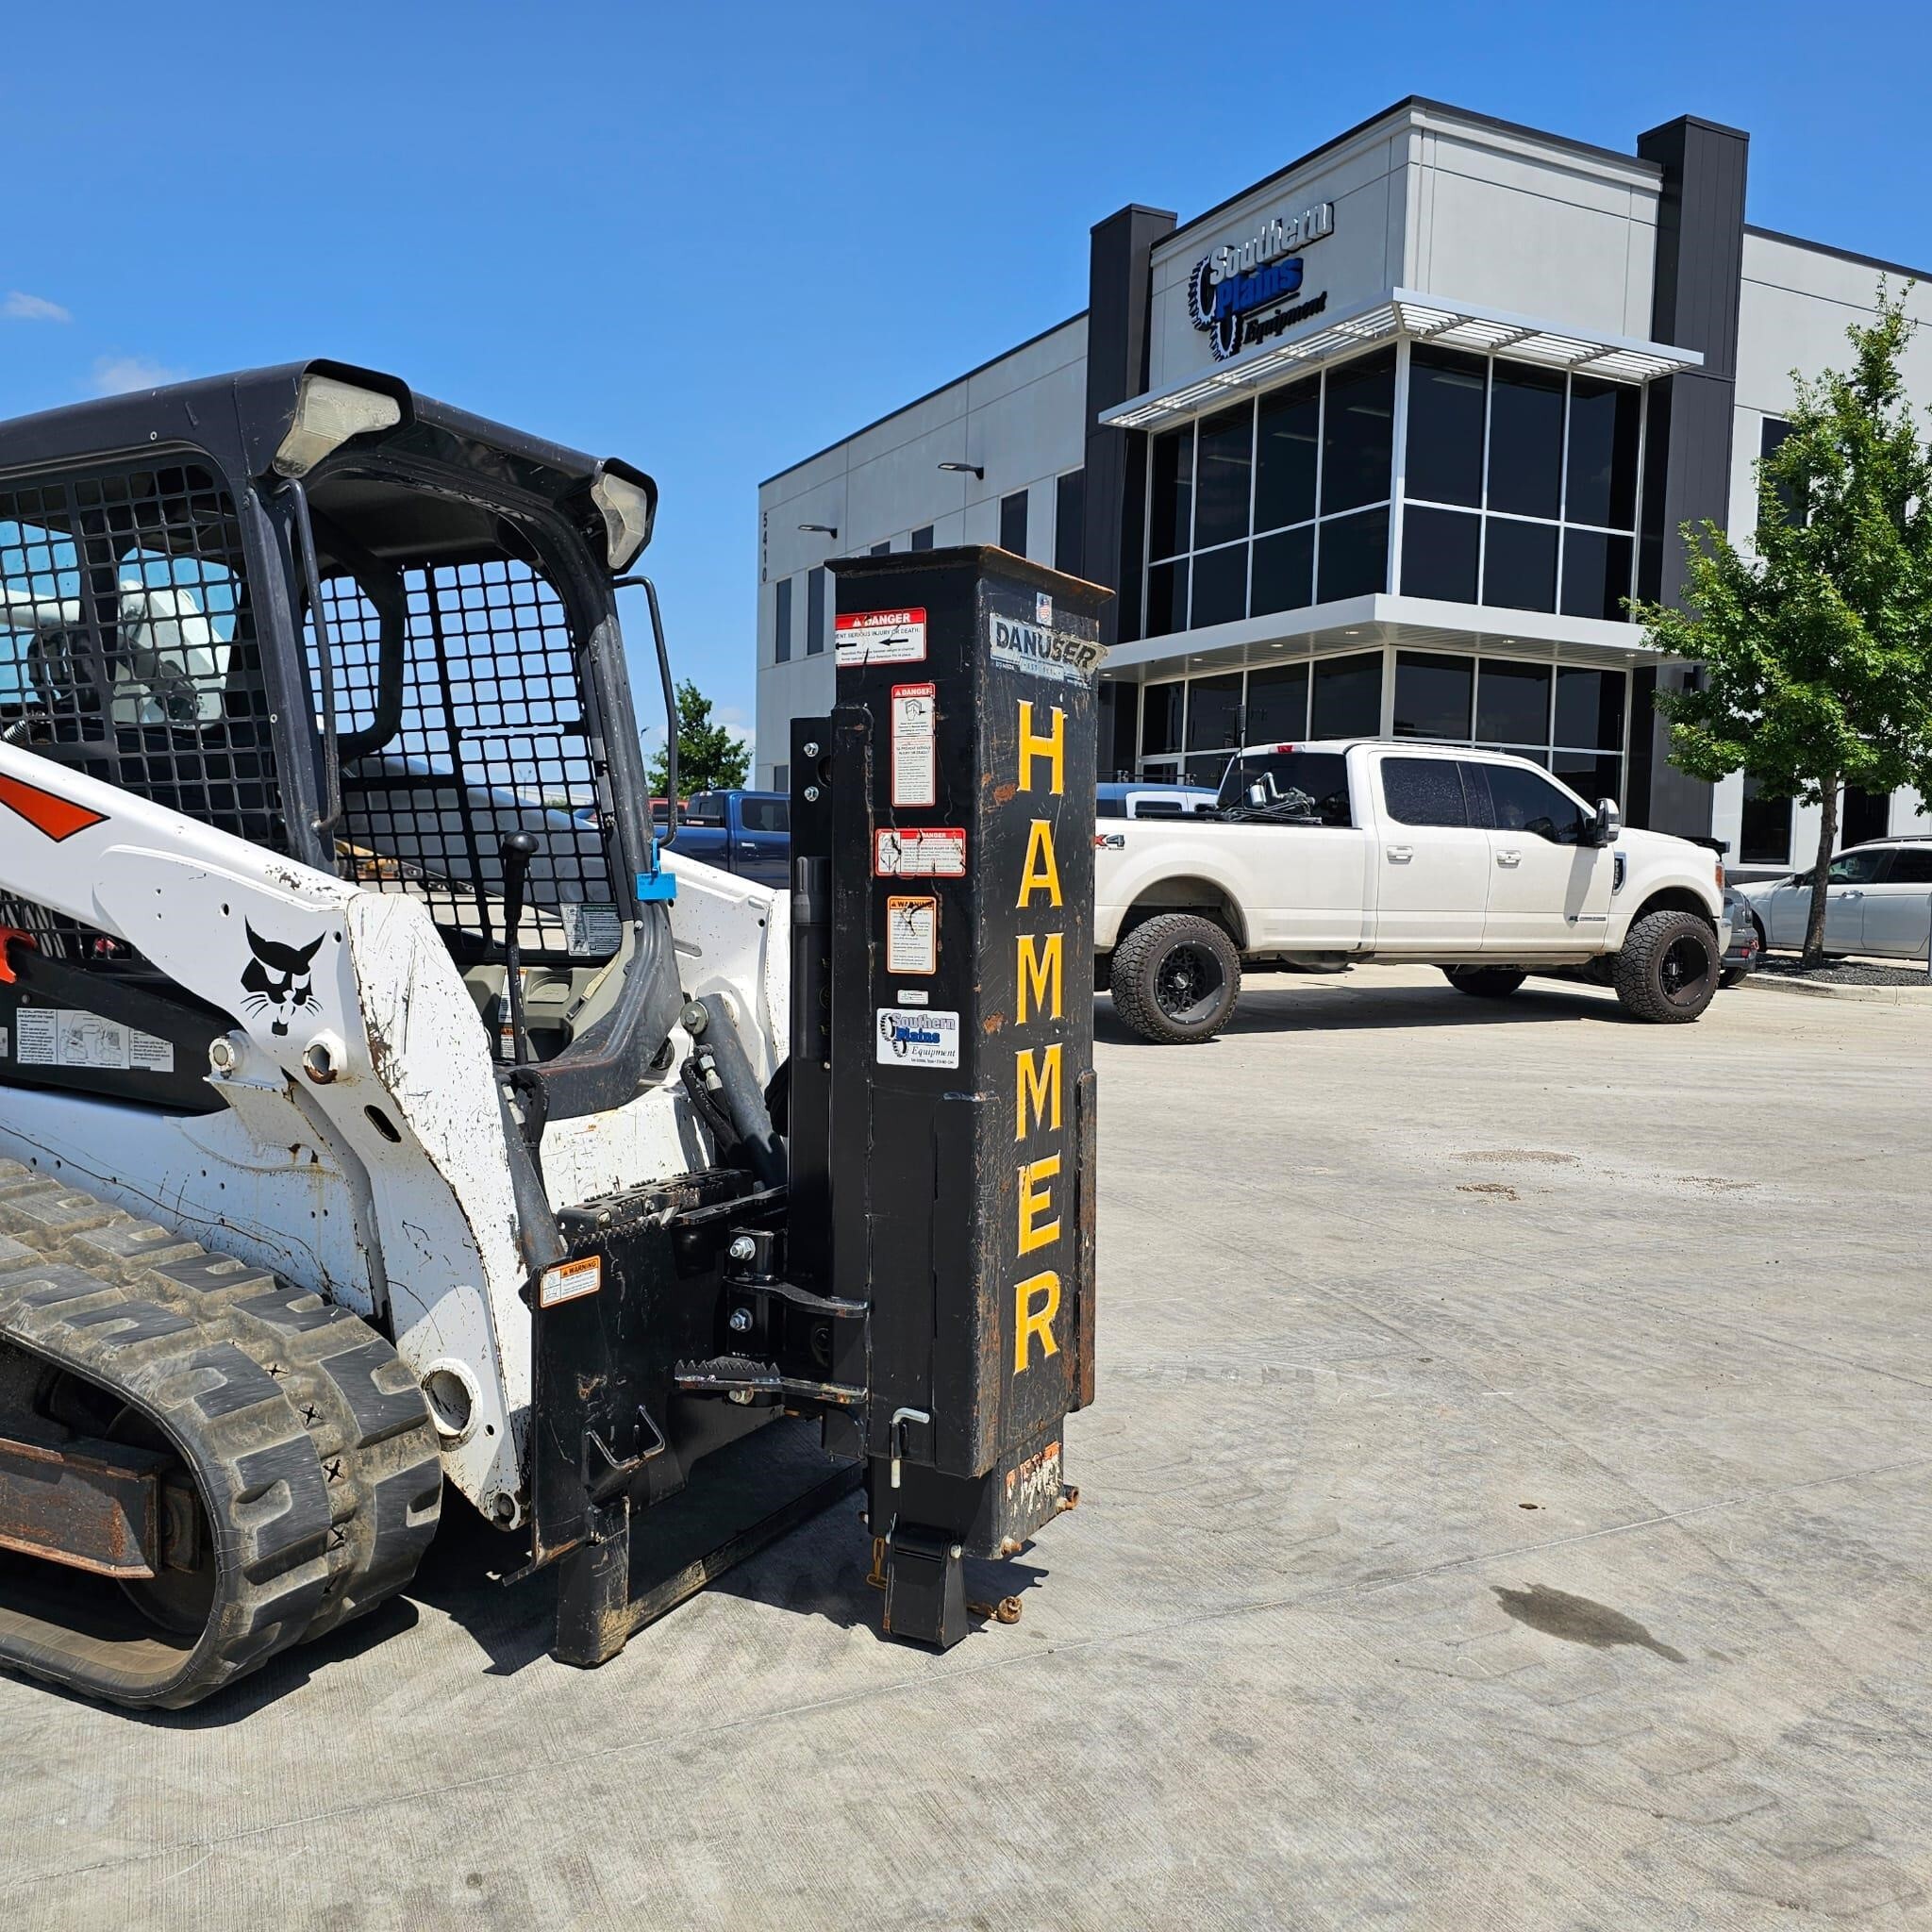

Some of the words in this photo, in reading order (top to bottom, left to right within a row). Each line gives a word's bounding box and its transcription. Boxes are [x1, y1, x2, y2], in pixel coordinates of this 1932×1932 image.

[1209, 202, 1335, 286] Southern
[1215, 258, 1304, 323] Plains
[1242, 291, 1328, 345] Equipment
[864, 612, 911, 626] DANGER
[996, 622, 1096, 669] DANUSER
[891, 1012, 956, 1030] Southern
[896, 1026, 941, 1043] Plains
[1014, 699, 1067, 1375] HAMMER
[911, 1046, 956, 1058] Equipment
[569, 1260, 596, 1274] WARNING
